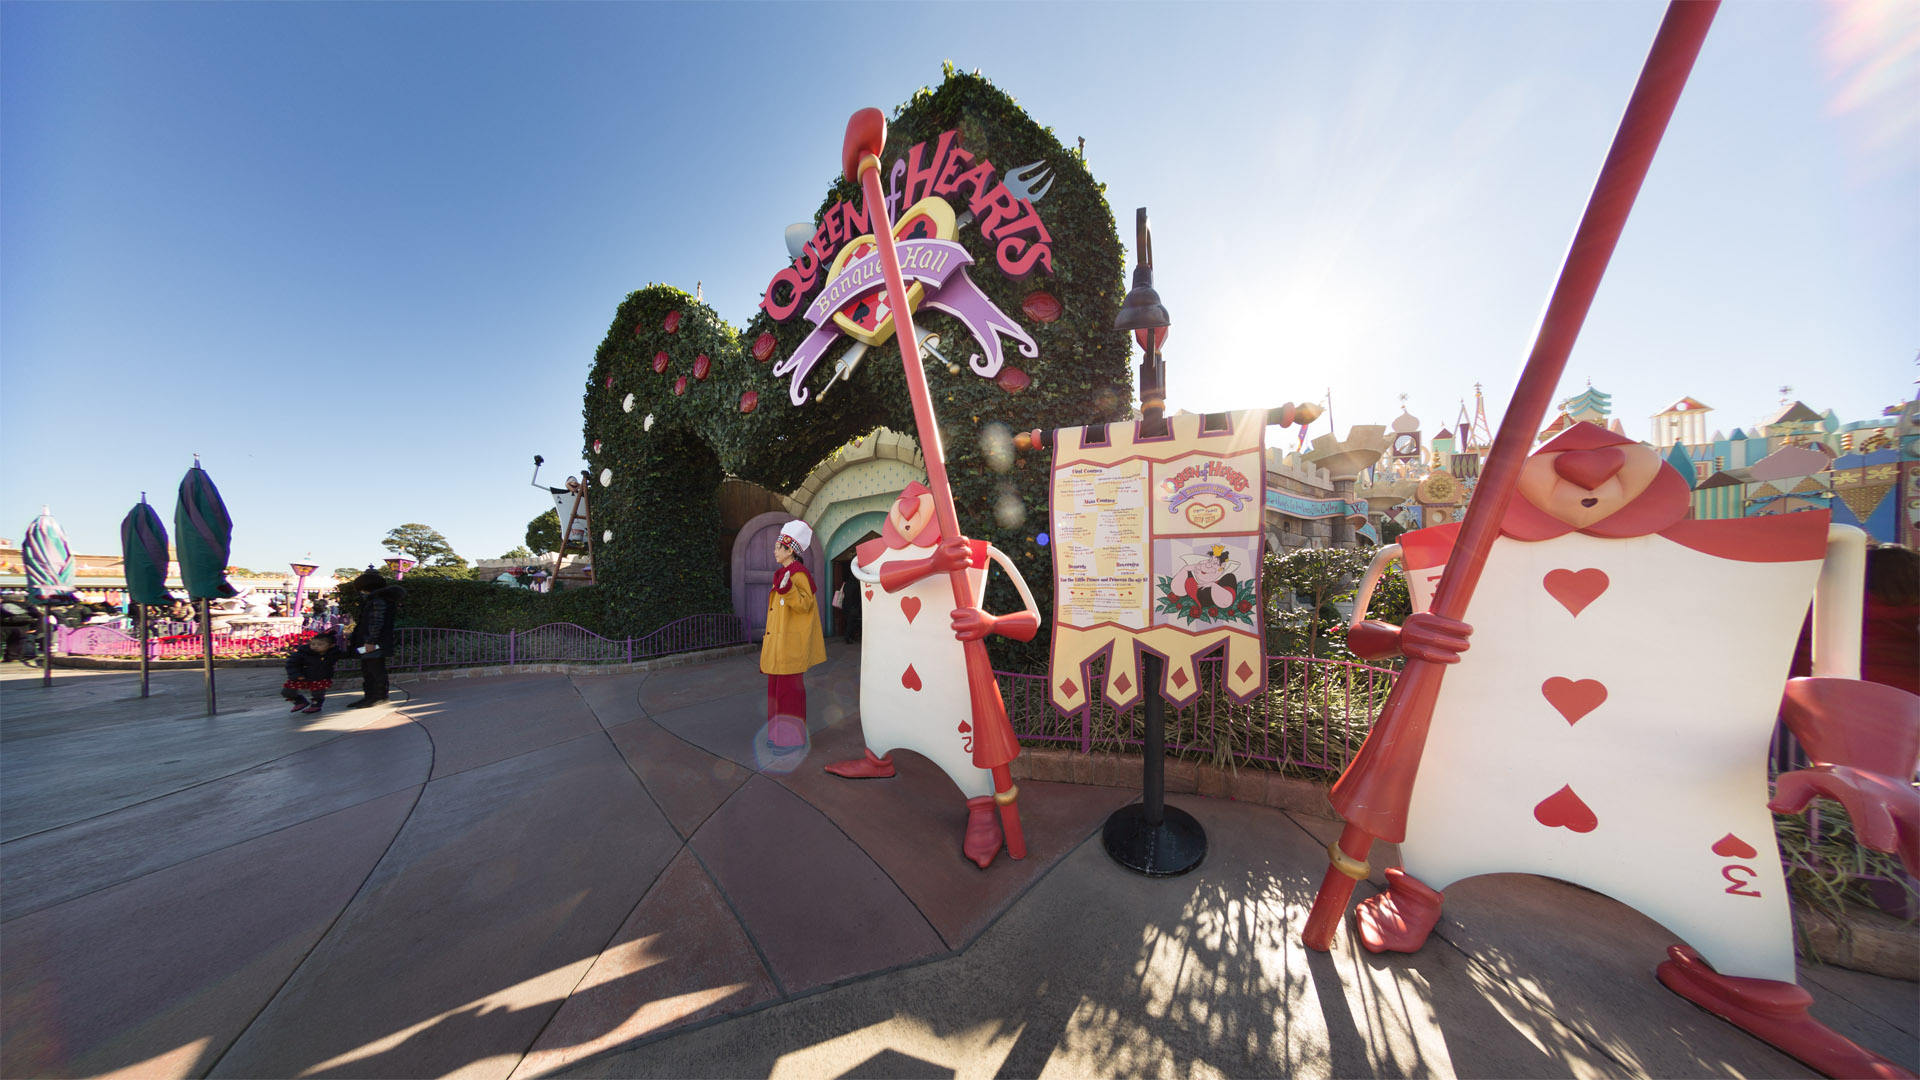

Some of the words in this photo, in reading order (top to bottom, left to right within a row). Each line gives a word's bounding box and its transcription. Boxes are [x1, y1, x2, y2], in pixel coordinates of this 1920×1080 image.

[759, 186, 870, 321] QUEEN
[901, 129, 1053, 276] HEARTS
[816, 259, 883, 318] Banque
[900, 246, 949, 273] Hall
[1160, 465, 1200, 493] QUEEN
[1199, 463, 1210, 482] of
[1208, 461, 1250, 492] HEARTS
[962, 736, 974, 753] 2
[1721, 864, 1762, 898] 3
